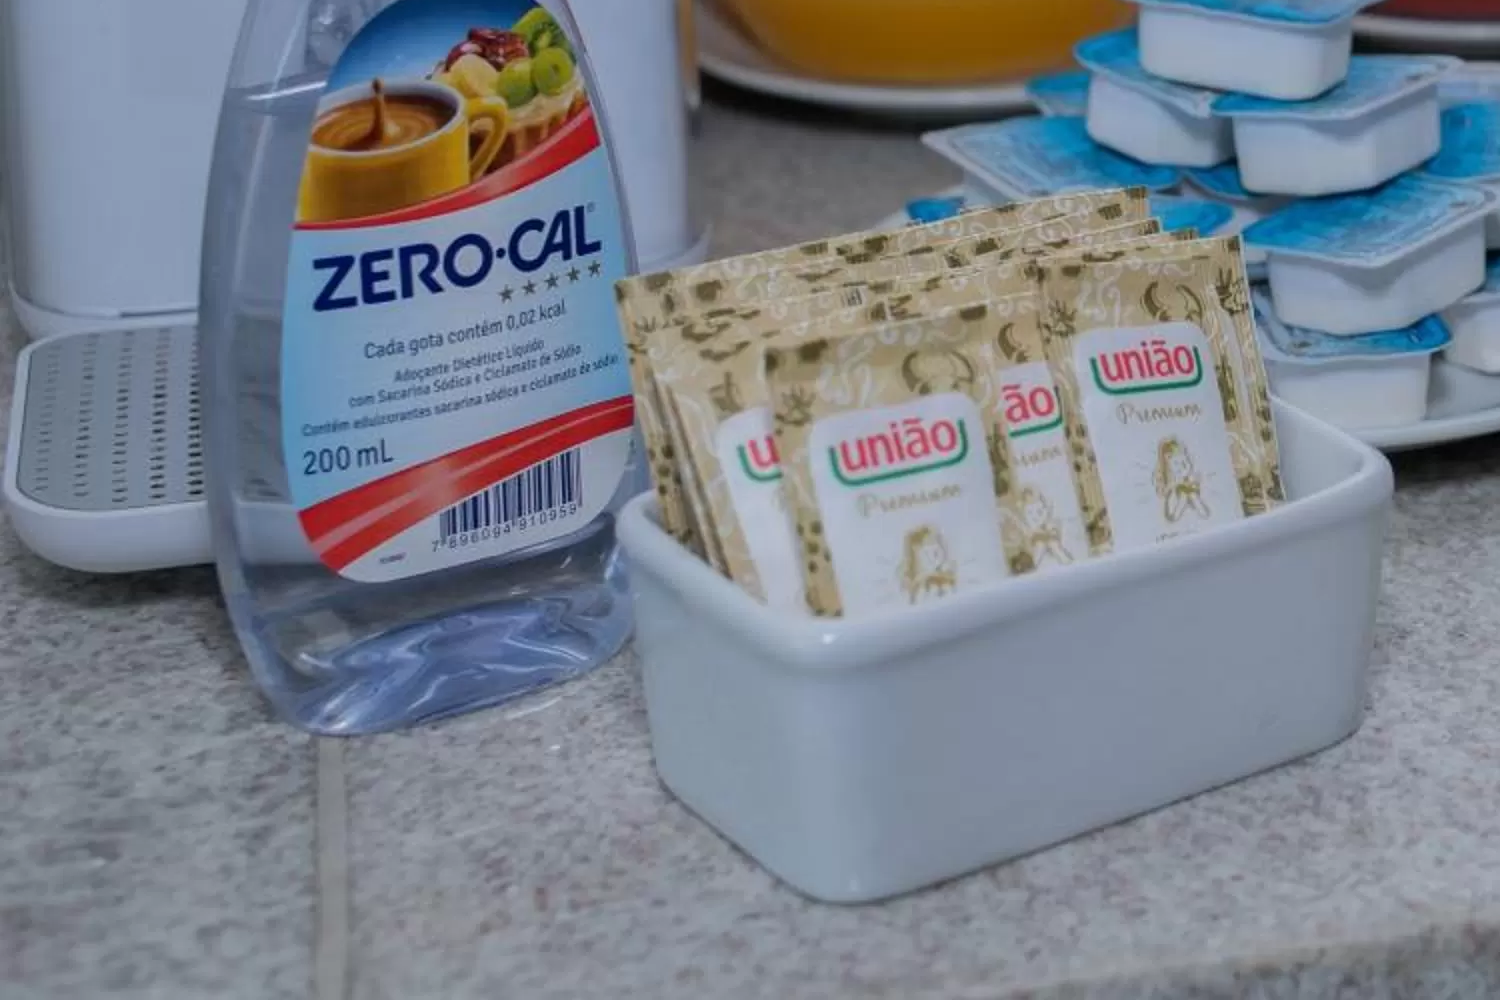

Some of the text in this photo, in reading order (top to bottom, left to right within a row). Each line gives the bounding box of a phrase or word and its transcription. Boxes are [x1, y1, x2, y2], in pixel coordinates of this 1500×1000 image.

[364, 338, 405, 359] Cada
[409, 333, 444, 356] gota
[448, 317, 503, 344] contém
[539, 299, 567, 319] kcal
[1101, 339, 1195, 382] união
[1117, 402, 1202, 425] Premium
[303, 438, 394, 475] 200 mL
[840, 417, 957, 472] união
[857, 483, 962, 518] Premium
